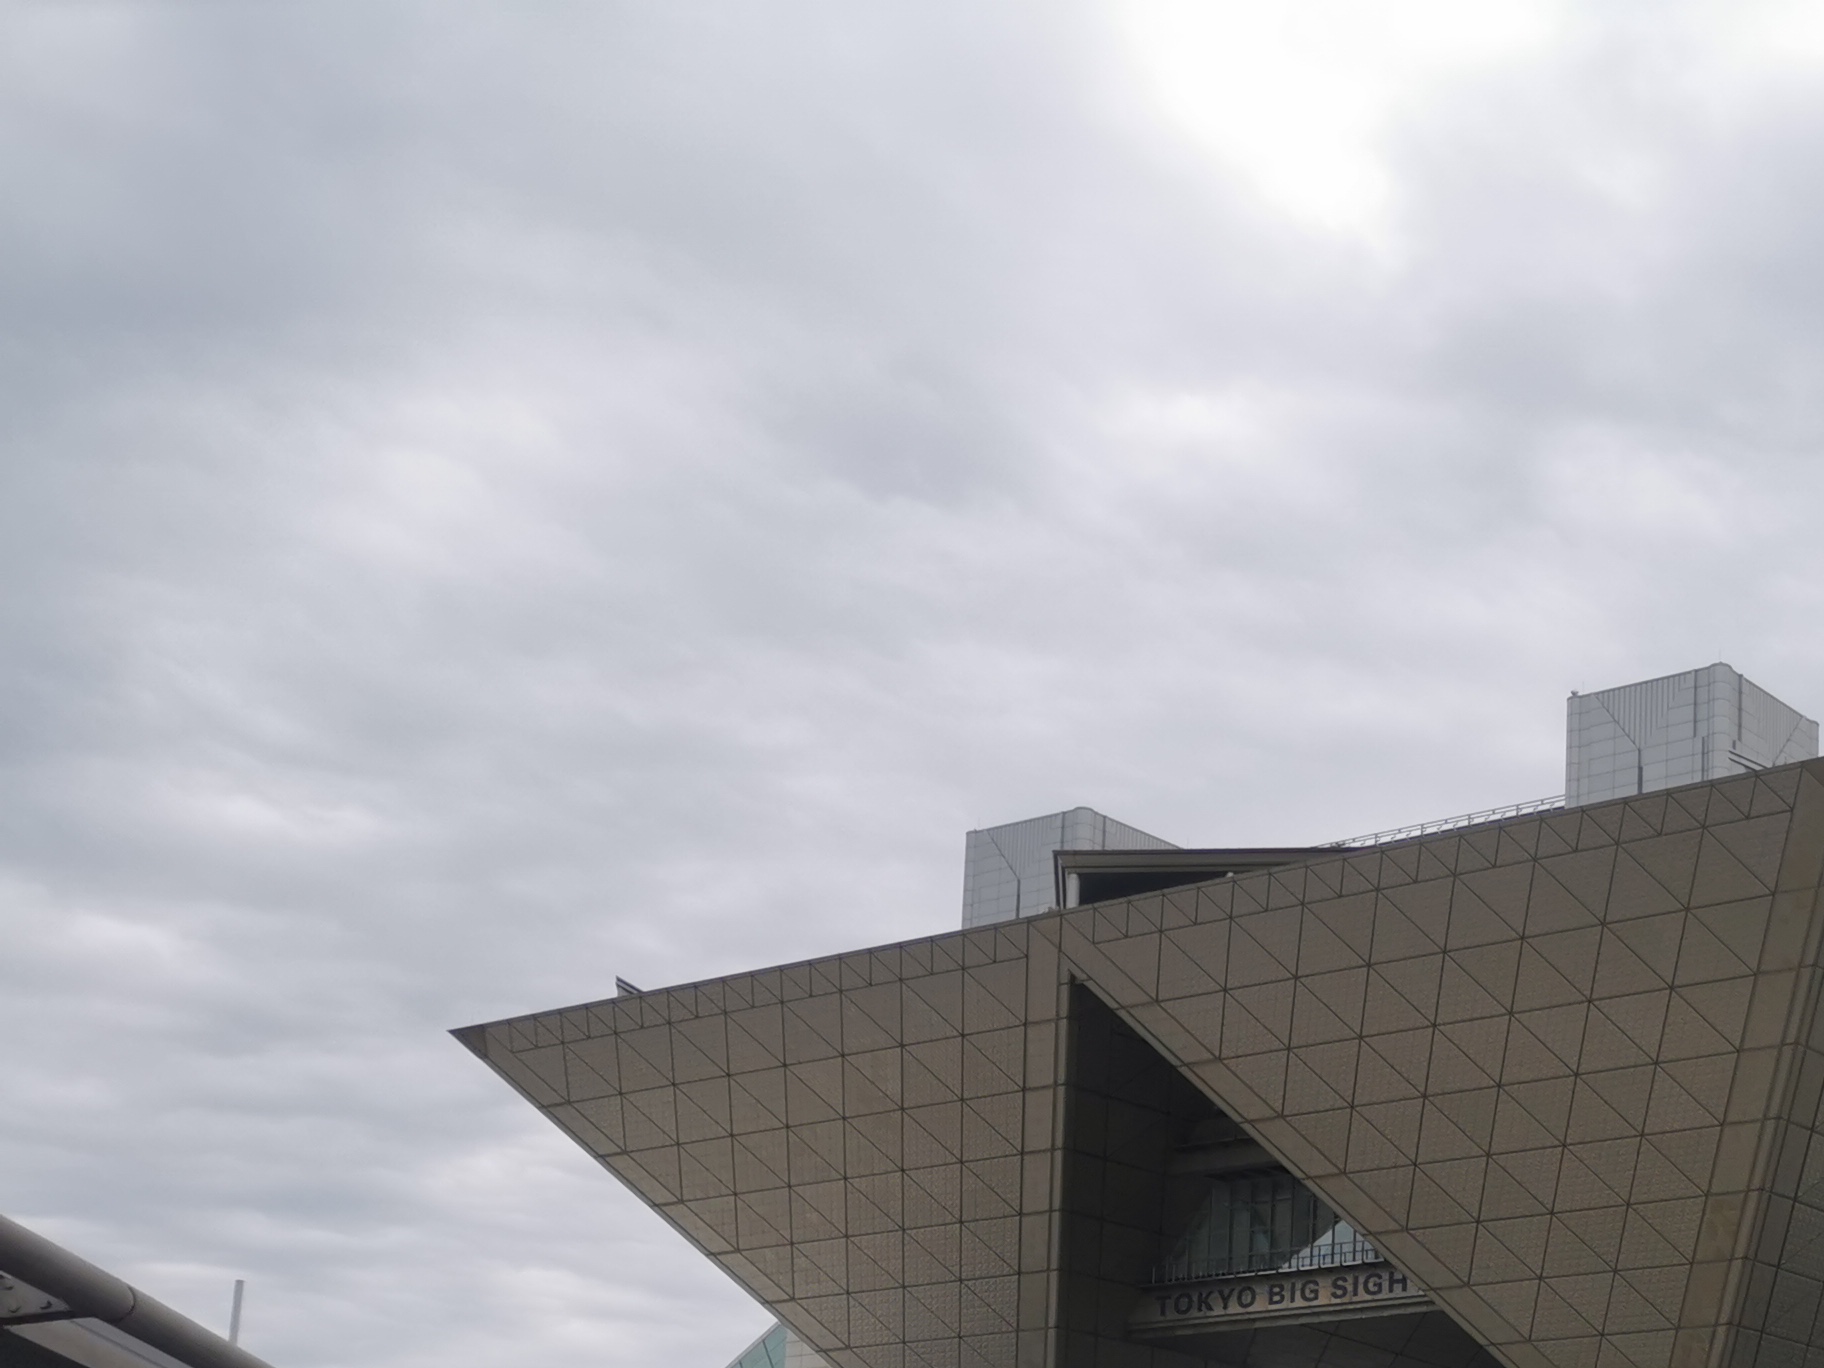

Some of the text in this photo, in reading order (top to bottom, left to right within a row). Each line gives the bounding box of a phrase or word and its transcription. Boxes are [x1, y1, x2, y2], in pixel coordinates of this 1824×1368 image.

[1157, 1271, 1408, 1316] TOKYO BIG SIGH
